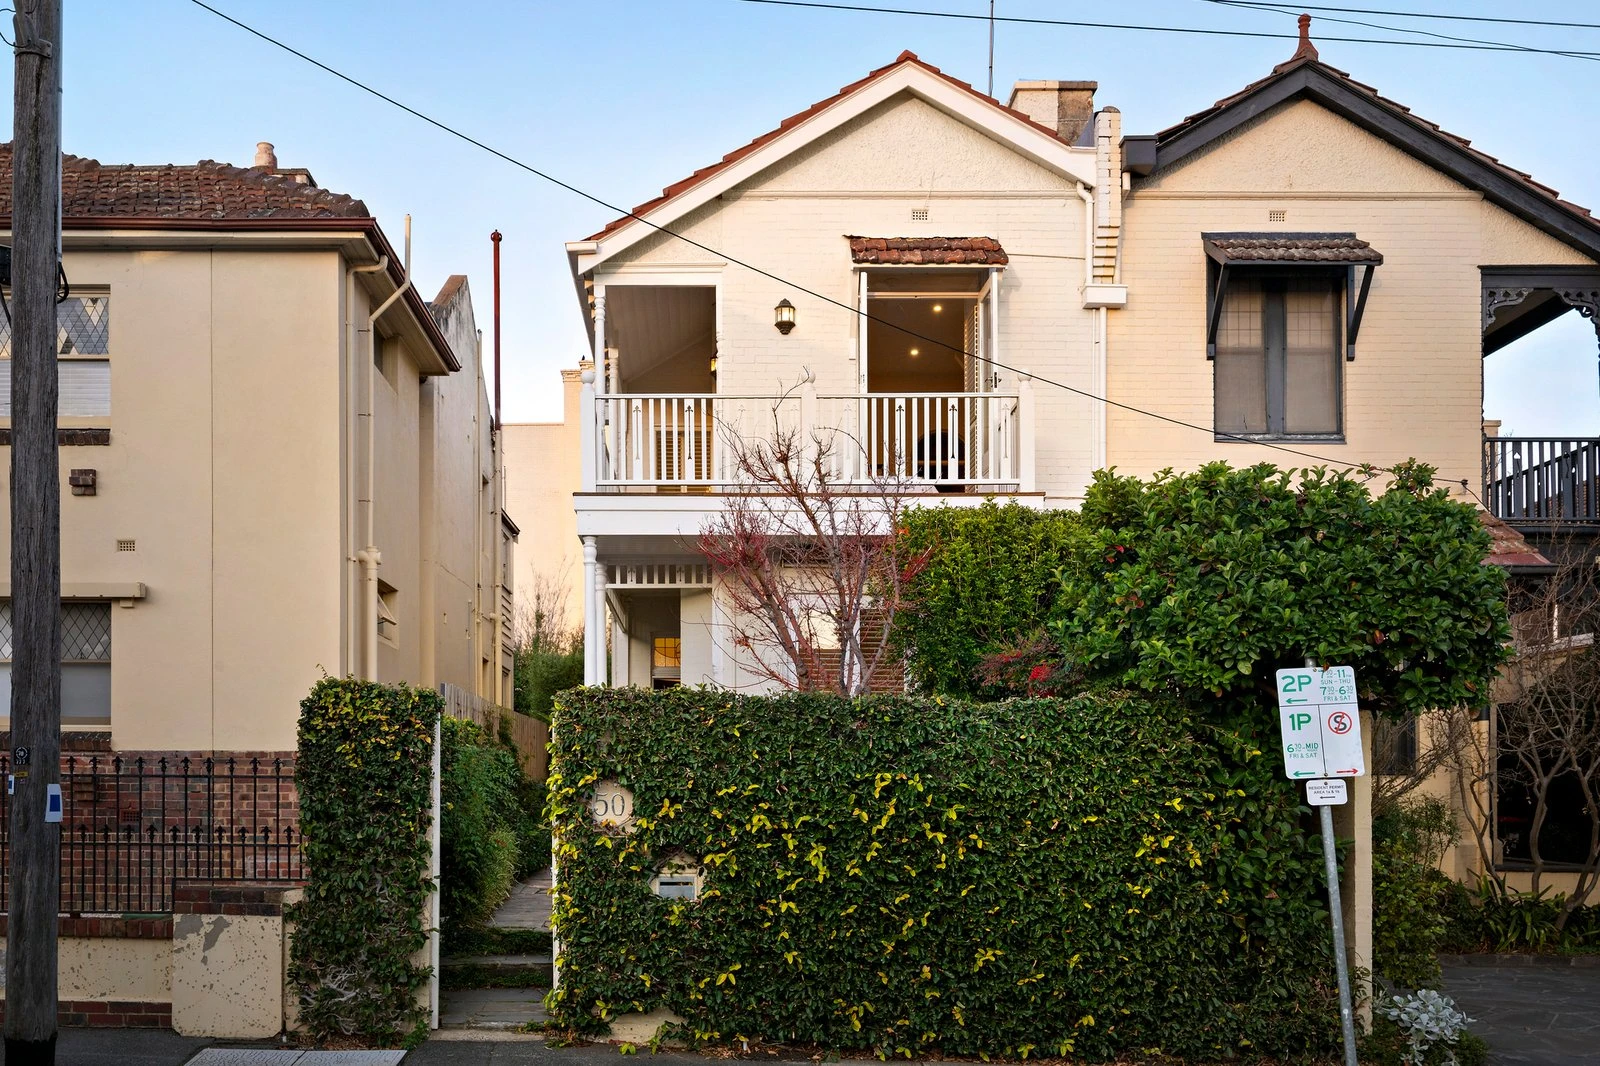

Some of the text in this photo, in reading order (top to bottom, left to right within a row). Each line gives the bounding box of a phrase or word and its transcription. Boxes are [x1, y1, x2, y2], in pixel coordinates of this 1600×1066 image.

[1281, 675, 1312, 693] 2P
[1289, 713, 1312, 731] 1P
[593, 792, 626, 817] 50
